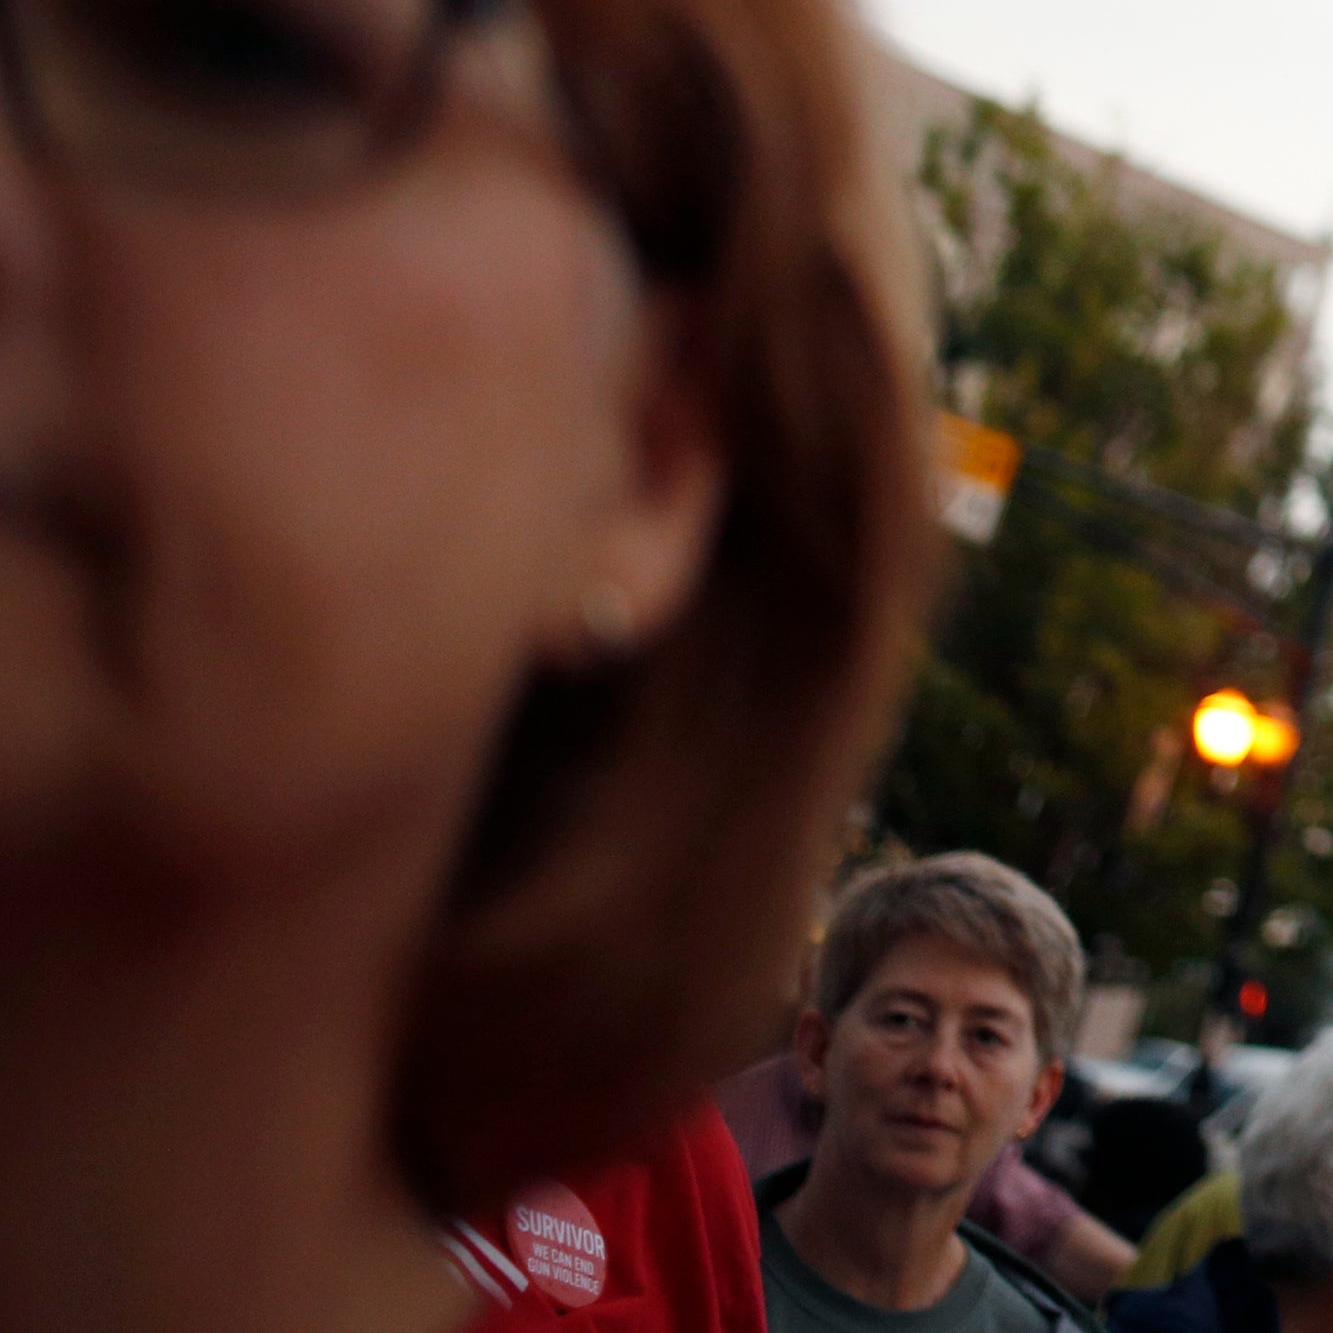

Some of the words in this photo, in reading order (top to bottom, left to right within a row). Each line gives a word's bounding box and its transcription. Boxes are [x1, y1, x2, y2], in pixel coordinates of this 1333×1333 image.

[517, 1206, 605, 1260] SURVIVOR
[528, 1258, 550, 1276] GUN
[553, 1267, 599, 1295] VIOLENCE
[533, 1243, 549, 1260] WE
[552, 1249, 572, 1267] CAN
[575, 1257, 594, 1275] END
